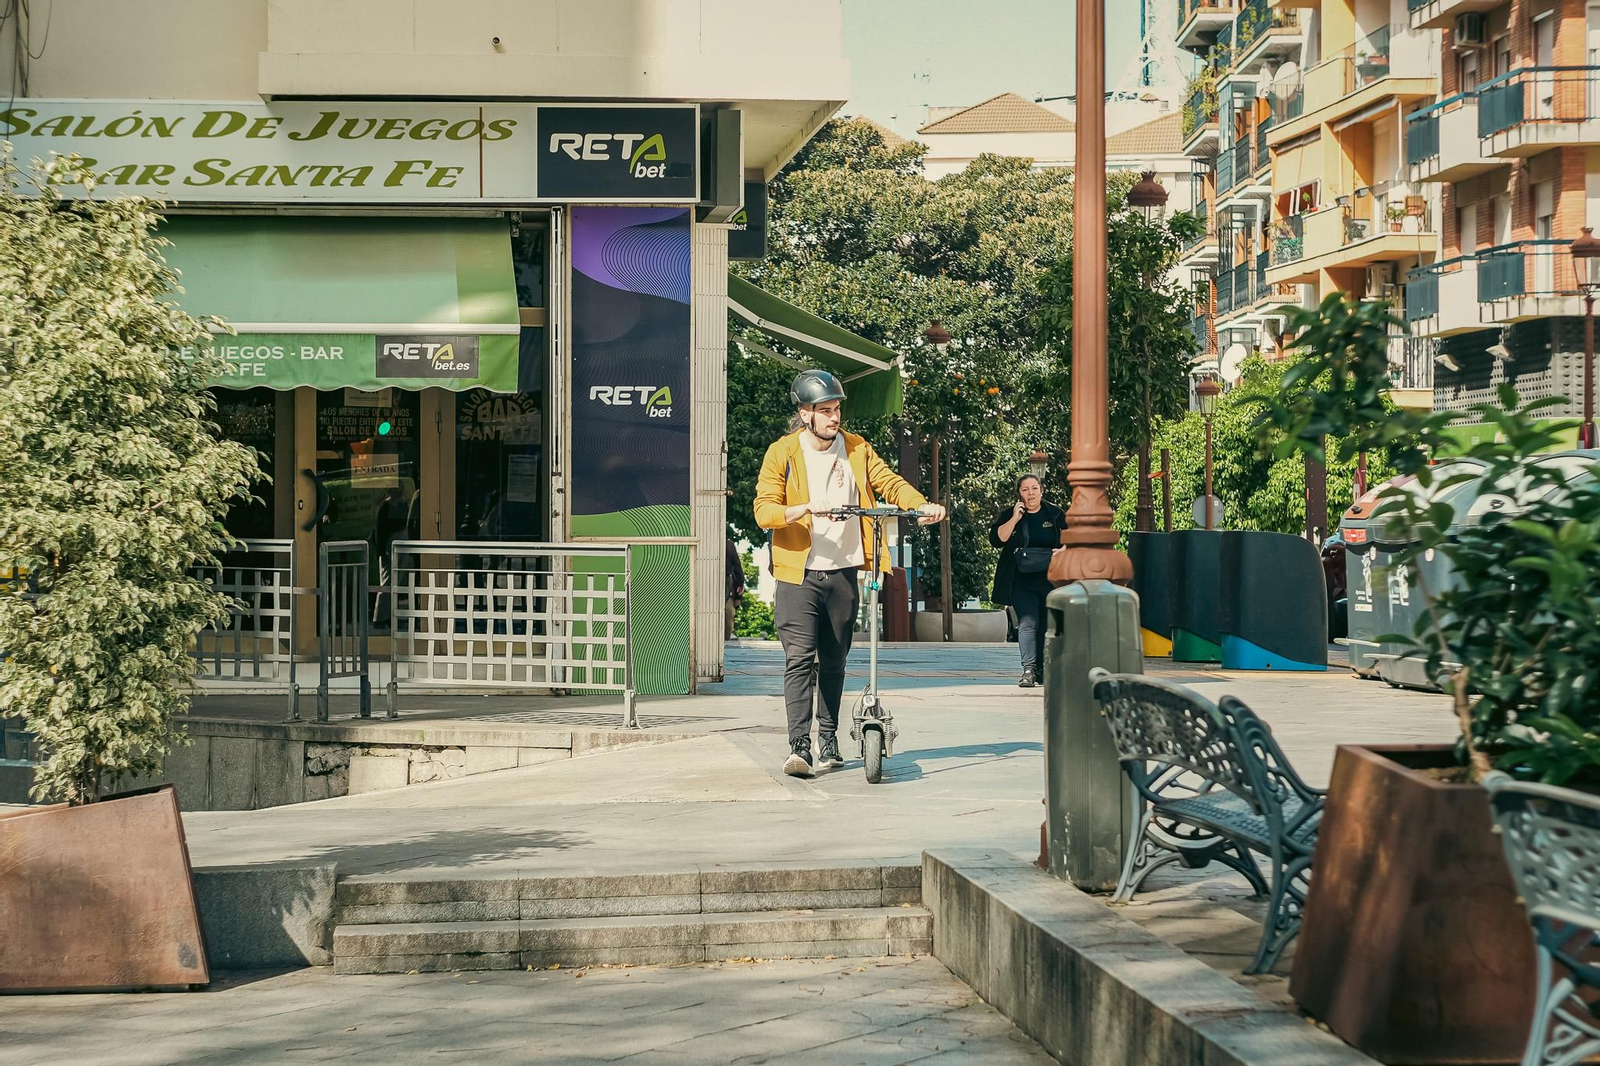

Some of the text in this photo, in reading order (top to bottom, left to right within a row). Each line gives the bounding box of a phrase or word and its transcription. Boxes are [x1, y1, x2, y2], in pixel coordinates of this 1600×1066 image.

[192, 110, 284, 139] DE
[287, 111, 518, 141] JUEGOS
[549, 133, 667, 174] RETA
[183, 158, 375, 187] SANTA
[384, 160, 464, 188] FE
[634, 161, 667, 179] bet
[204, 346, 284, 360] UEGOS
[300, 346, 344, 360] BAR
[383, 342, 454, 367] RETA
[434, 359, 470, 371] bet.es
[589, 385, 672, 413] RETA
[649, 404, 672, 418] bet
[354, 466, 396, 474] ENTRADA
